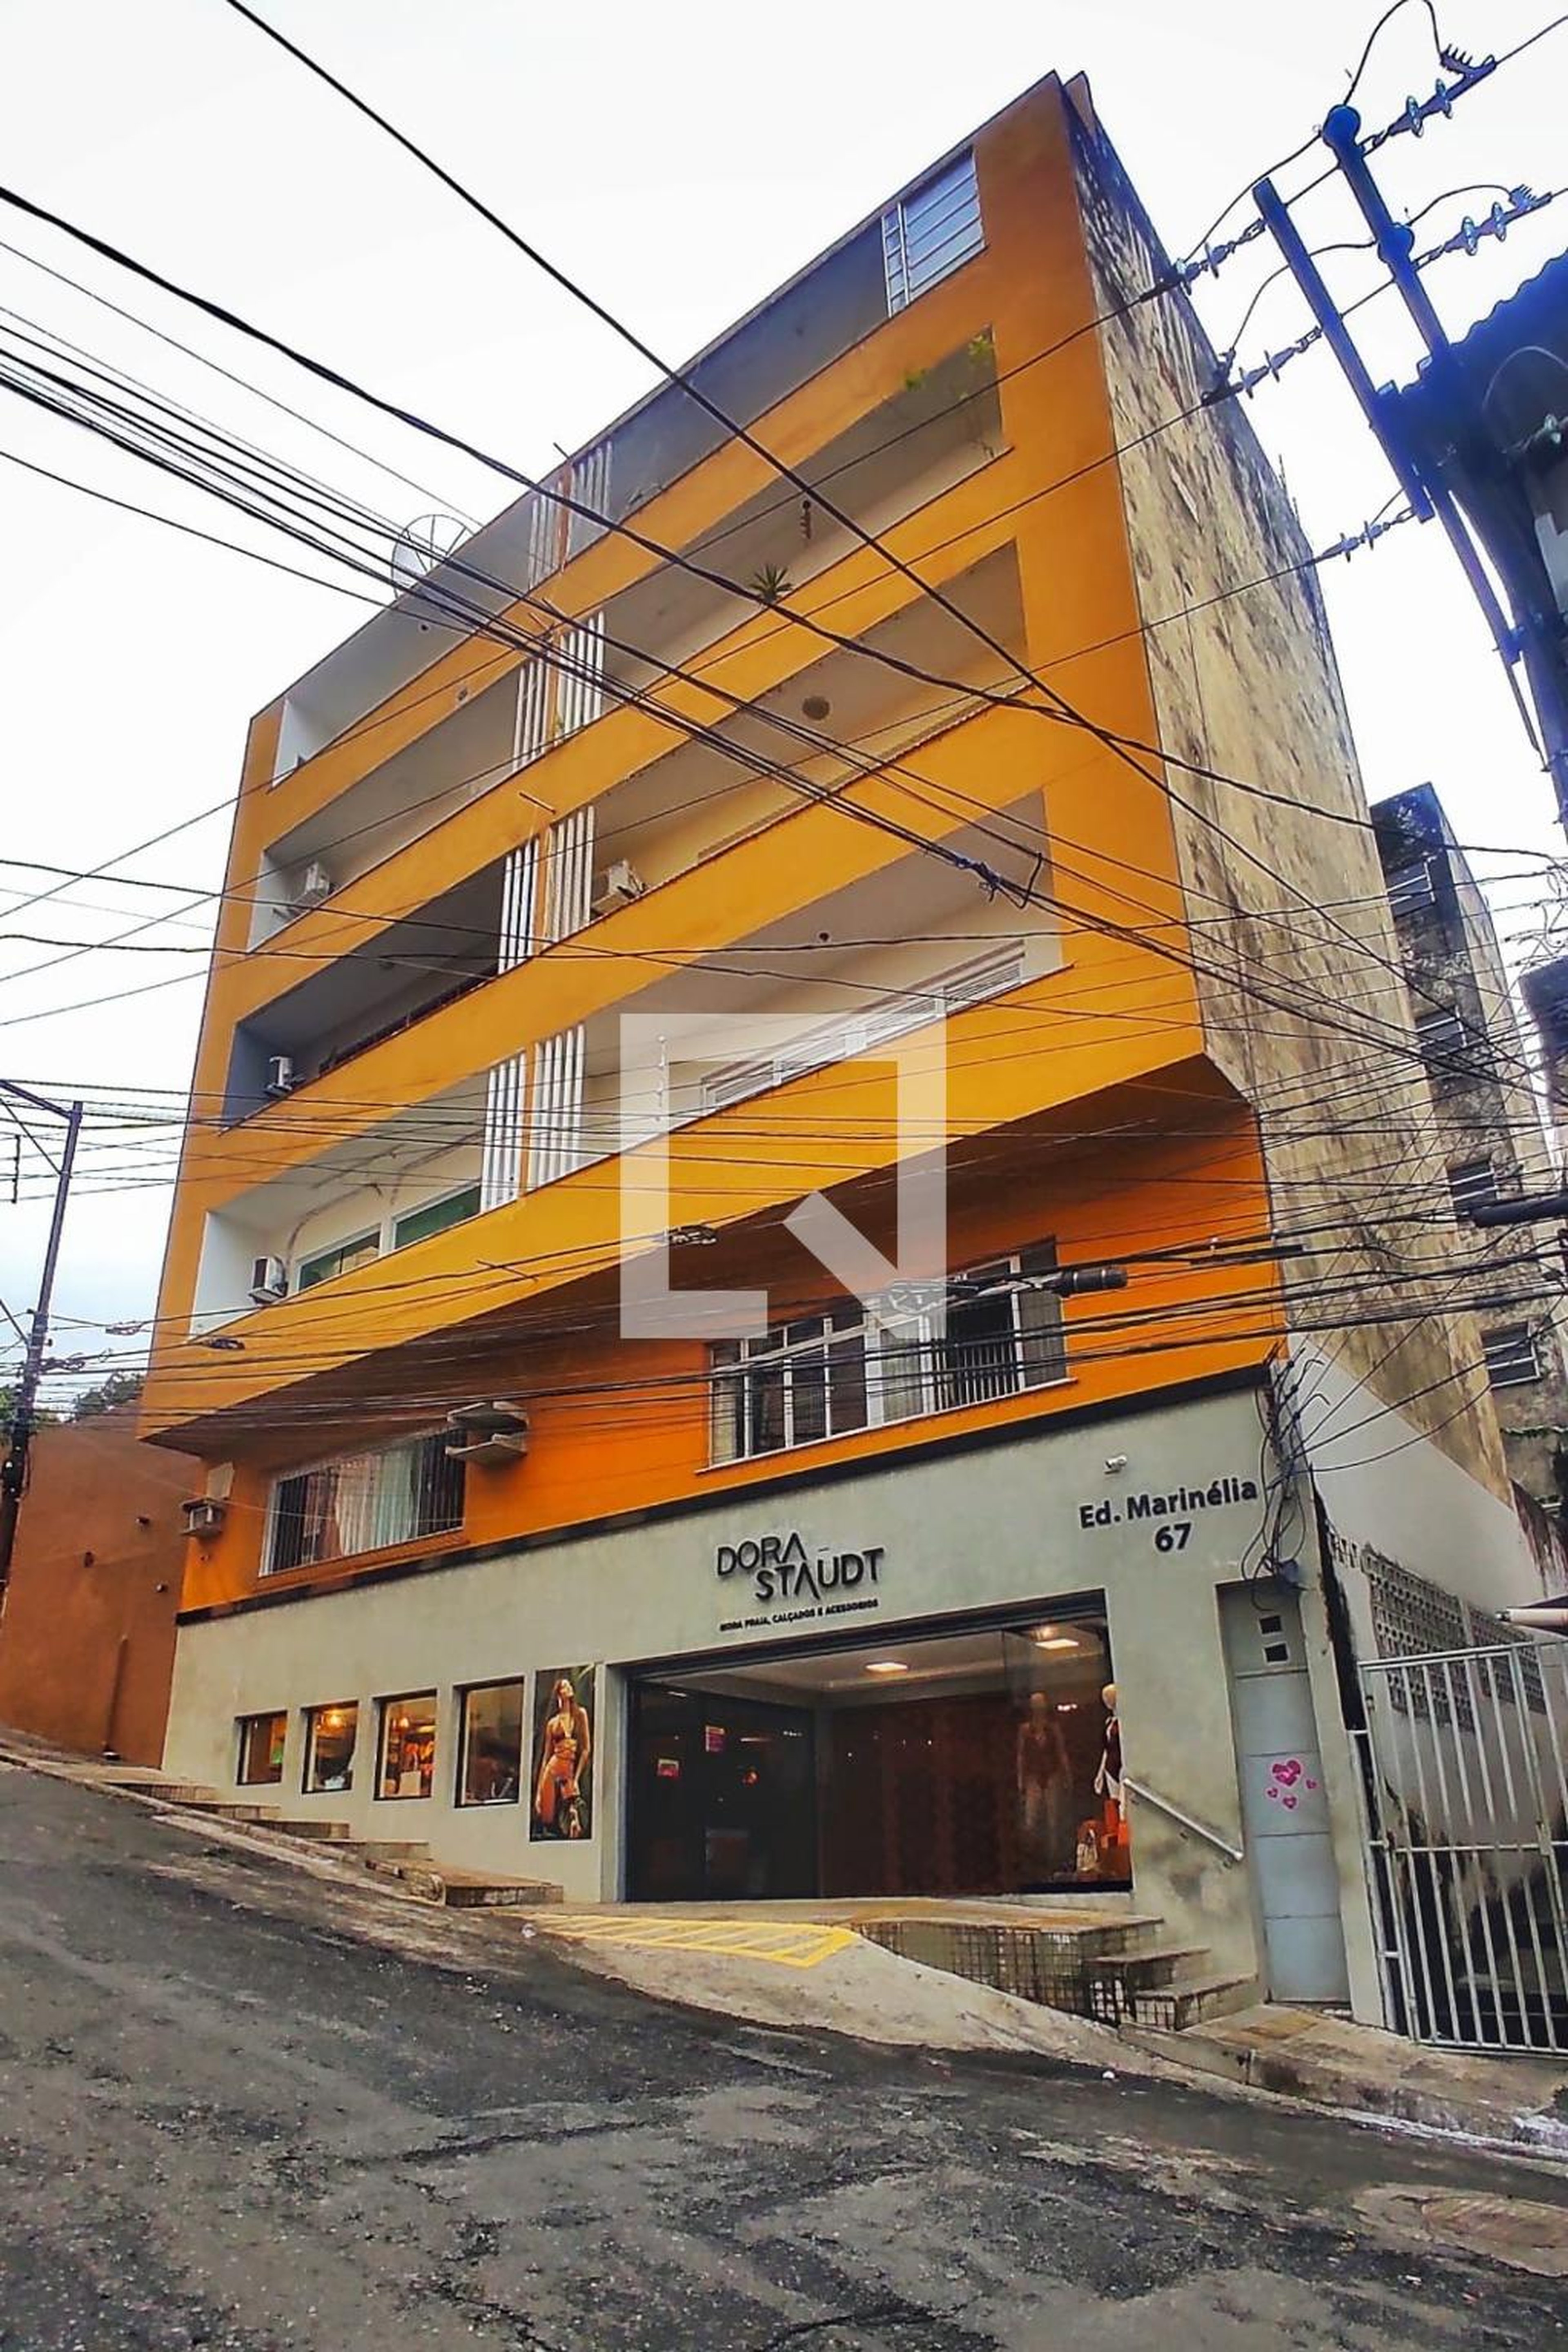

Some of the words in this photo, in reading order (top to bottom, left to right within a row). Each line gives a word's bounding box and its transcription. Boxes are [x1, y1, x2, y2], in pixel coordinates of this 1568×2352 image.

[1080, 1501, 1120, 1528] Ed.
[1127, 1478, 1257, 1519] Marinélia
[717, 1532, 807, 1576] DORA
[1155, 1523, 1192, 1552] 67
